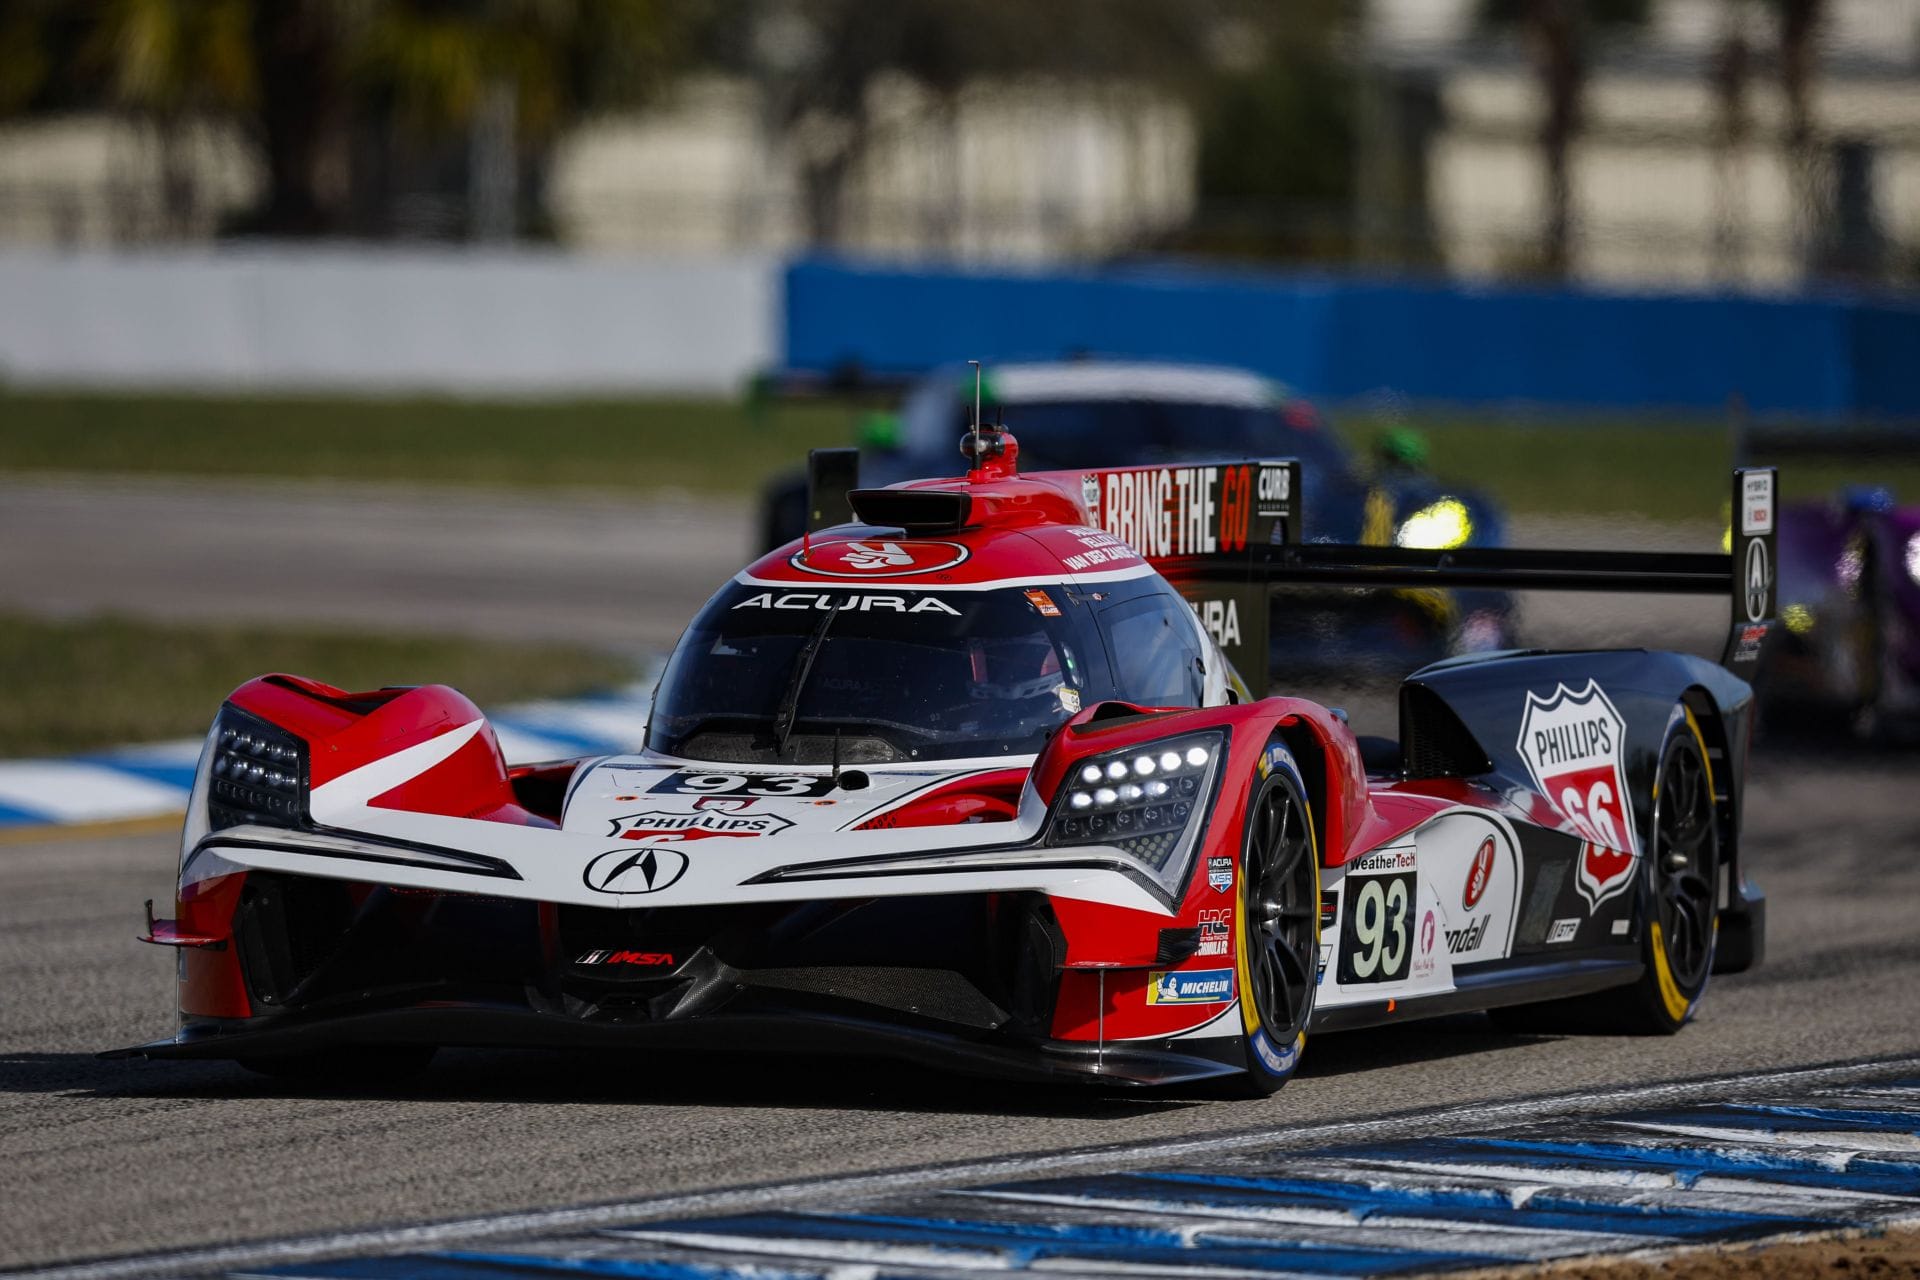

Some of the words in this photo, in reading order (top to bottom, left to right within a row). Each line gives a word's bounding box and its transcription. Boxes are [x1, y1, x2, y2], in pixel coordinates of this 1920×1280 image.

[1258, 468, 1290, 500] CURB
[1106, 469, 1171, 557] BRING
[1176, 467, 1217, 555] THE
[1219, 464, 1250, 553] GO
[1063, 554, 1091, 570] VAN
[1083, 549, 1109, 565] DER
[732, 593, 962, 616] ACURA
[1534, 717, 1612, 767] PHILLIPS
[676, 774, 819, 797] 93
[633, 816, 770, 830] PHILLIPS
[1561, 781, 1623, 857] 66
[1212, 857, 1233, 867] ACURA
[1350, 852, 1416, 871] WeatherTech
[1210, 873, 1232, 883] MSR
[1353, 878, 1408, 978] 93
[1444, 914, 1491, 954] ndall
[608, 950, 674, 965] IMSA
[1180, 980, 1229, 995] MICHELIN
